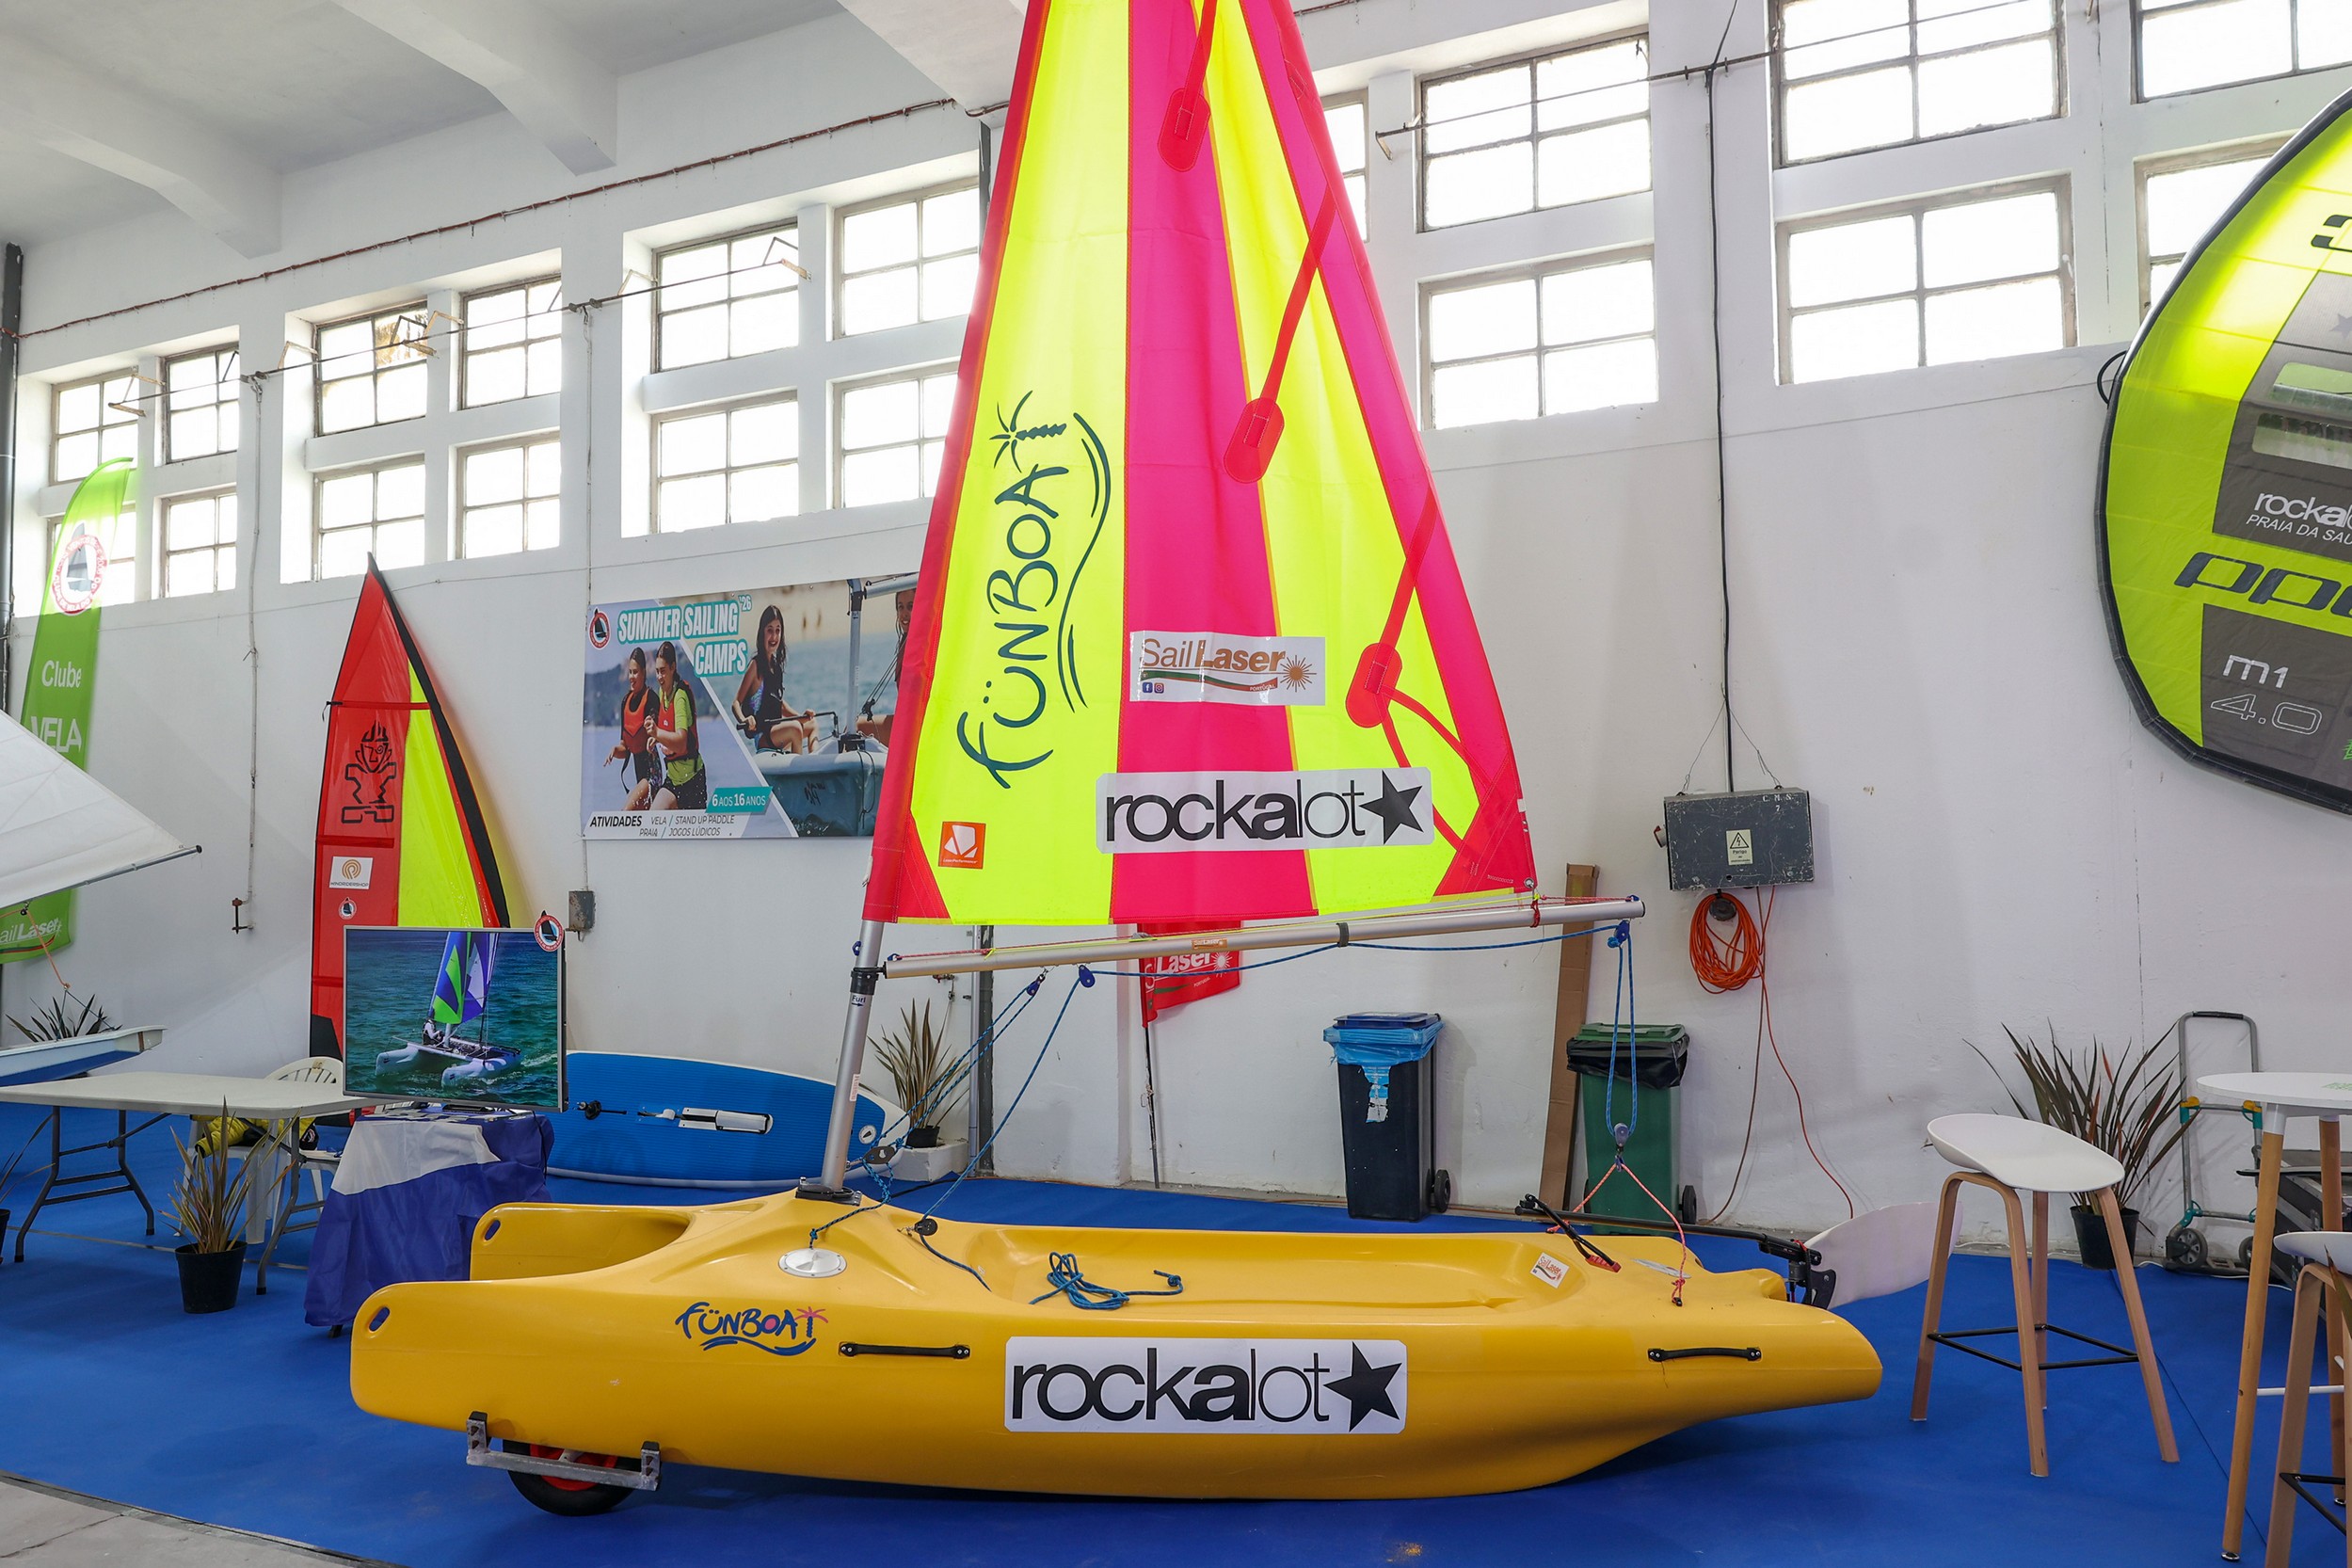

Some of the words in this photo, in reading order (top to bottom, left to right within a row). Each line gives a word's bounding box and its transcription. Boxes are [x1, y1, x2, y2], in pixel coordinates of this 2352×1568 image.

[2246, 514, 2294, 533] PRAIA
[2296, 524, 2319, 538] DA
[618, 608, 680, 642] SUMMER
[683, 602, 738, 636] SAILING
[41, 660, 82, 688] Clube
[696, 642, 747, 675] CAMPS
[2211, 694, 2322, 735] 4.0
[30, 716, 82, 752] VELA
[712, 794, 718, 807] 6
[718, 796, 734, 807] AOS
[734, 793, 745, 807] 16
[745, 795, 766, 807] ANOS
[1106, 779, 1366, 842] rockalot
[589, 815, 643, 827] ATIVIDADES
[650, 816, 667, 825] VELA
[675, 816, 697, 825] STAND
[697, 815, 707, 824] UP
[708, 815, 735, 824] PADDLE
[639, 827, 658, 837] PRAIA
[668, 827, 691, 837] JOGOS
[691, 825, 721, 837] LÚDICOS
[1012, 1347, 1330, 1423] rockalot
